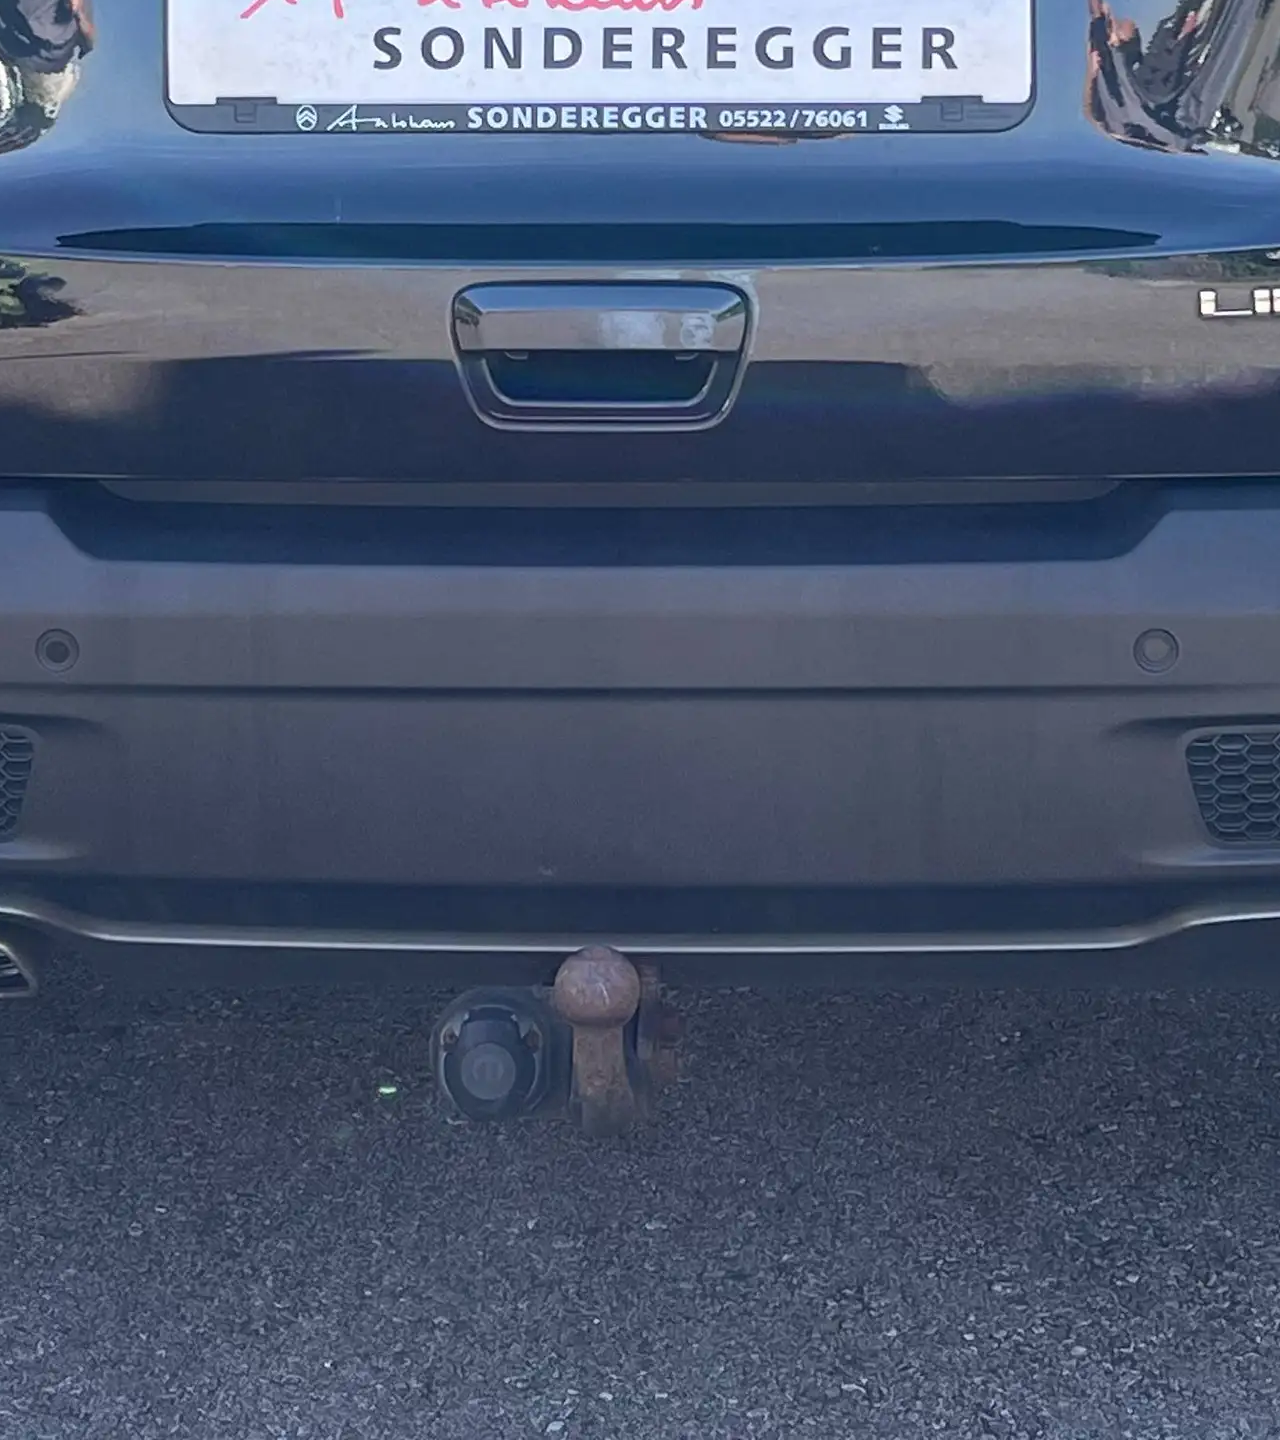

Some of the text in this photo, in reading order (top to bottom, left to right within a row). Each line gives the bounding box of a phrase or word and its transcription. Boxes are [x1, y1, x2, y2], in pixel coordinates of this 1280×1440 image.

[372, 25, 960, 71] SONDEREGGER
[467, 106, 708, 129] SONDEREGGER
[718, 109, 868, 129] 05522/76061
